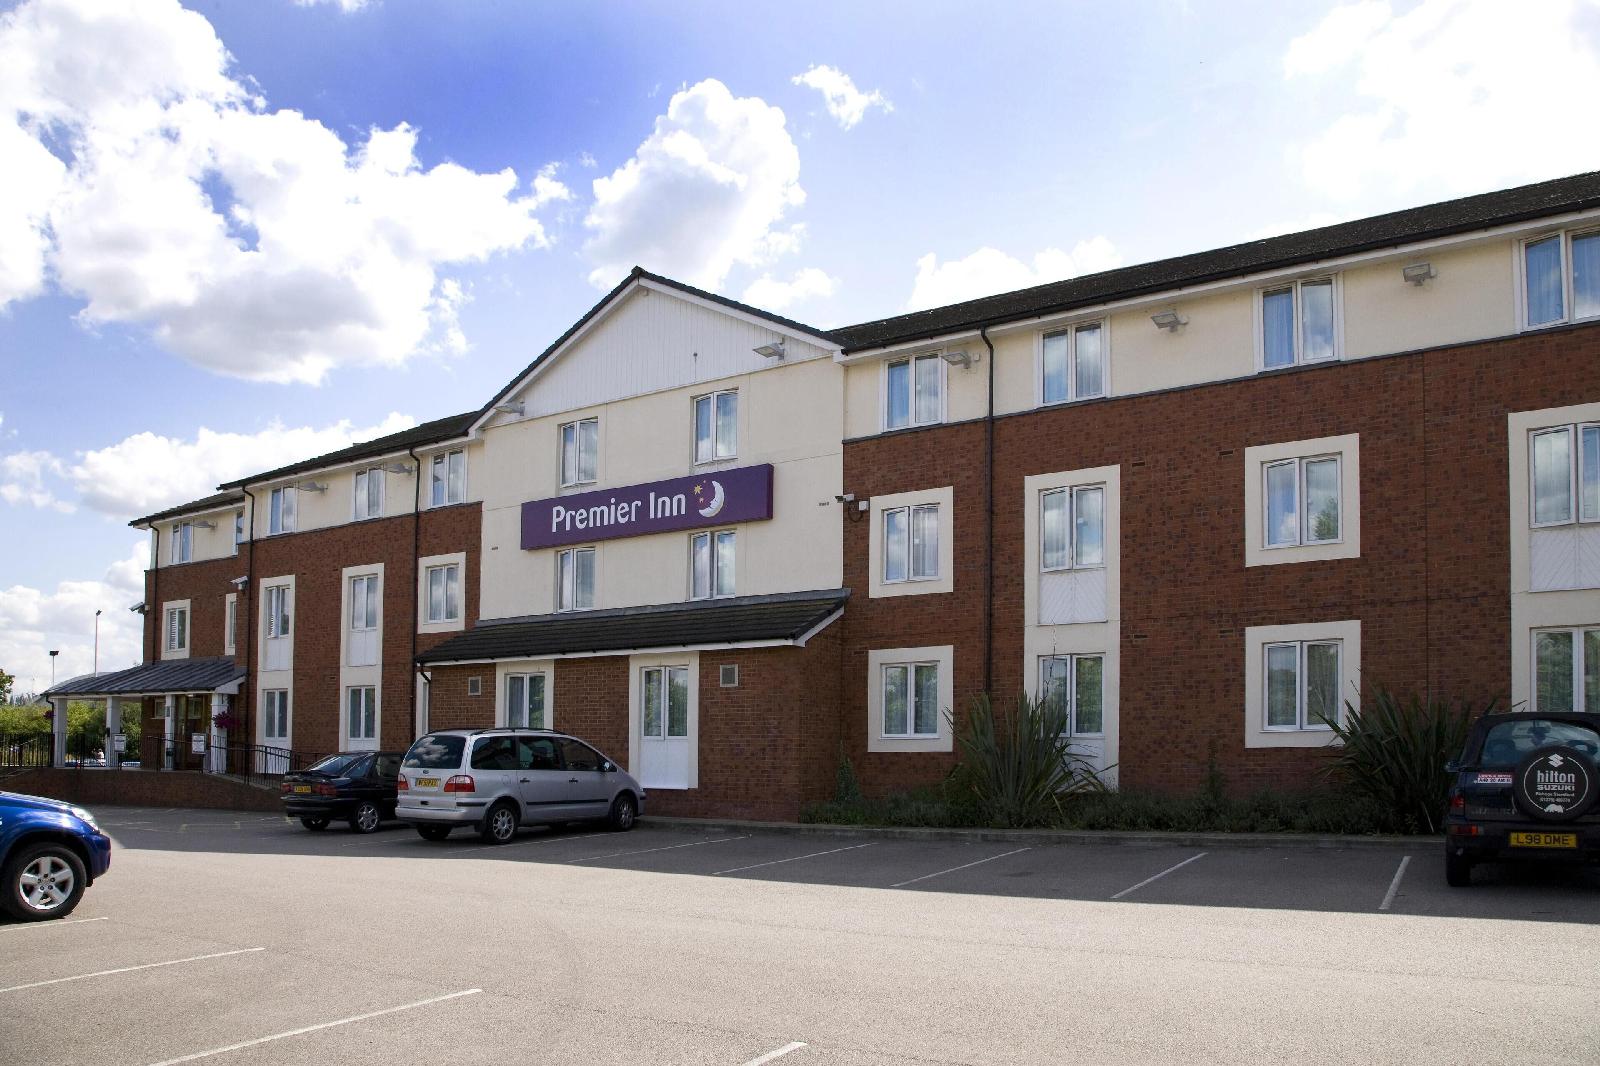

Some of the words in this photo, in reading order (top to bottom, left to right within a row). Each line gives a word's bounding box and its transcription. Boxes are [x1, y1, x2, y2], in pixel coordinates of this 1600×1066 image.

[552, 498, 641, 532] Premier
[649, 492, 686, 519] Inn
[1537, 770, 1575, 783] hilton
[1516, 833, 1541, 845] L98
